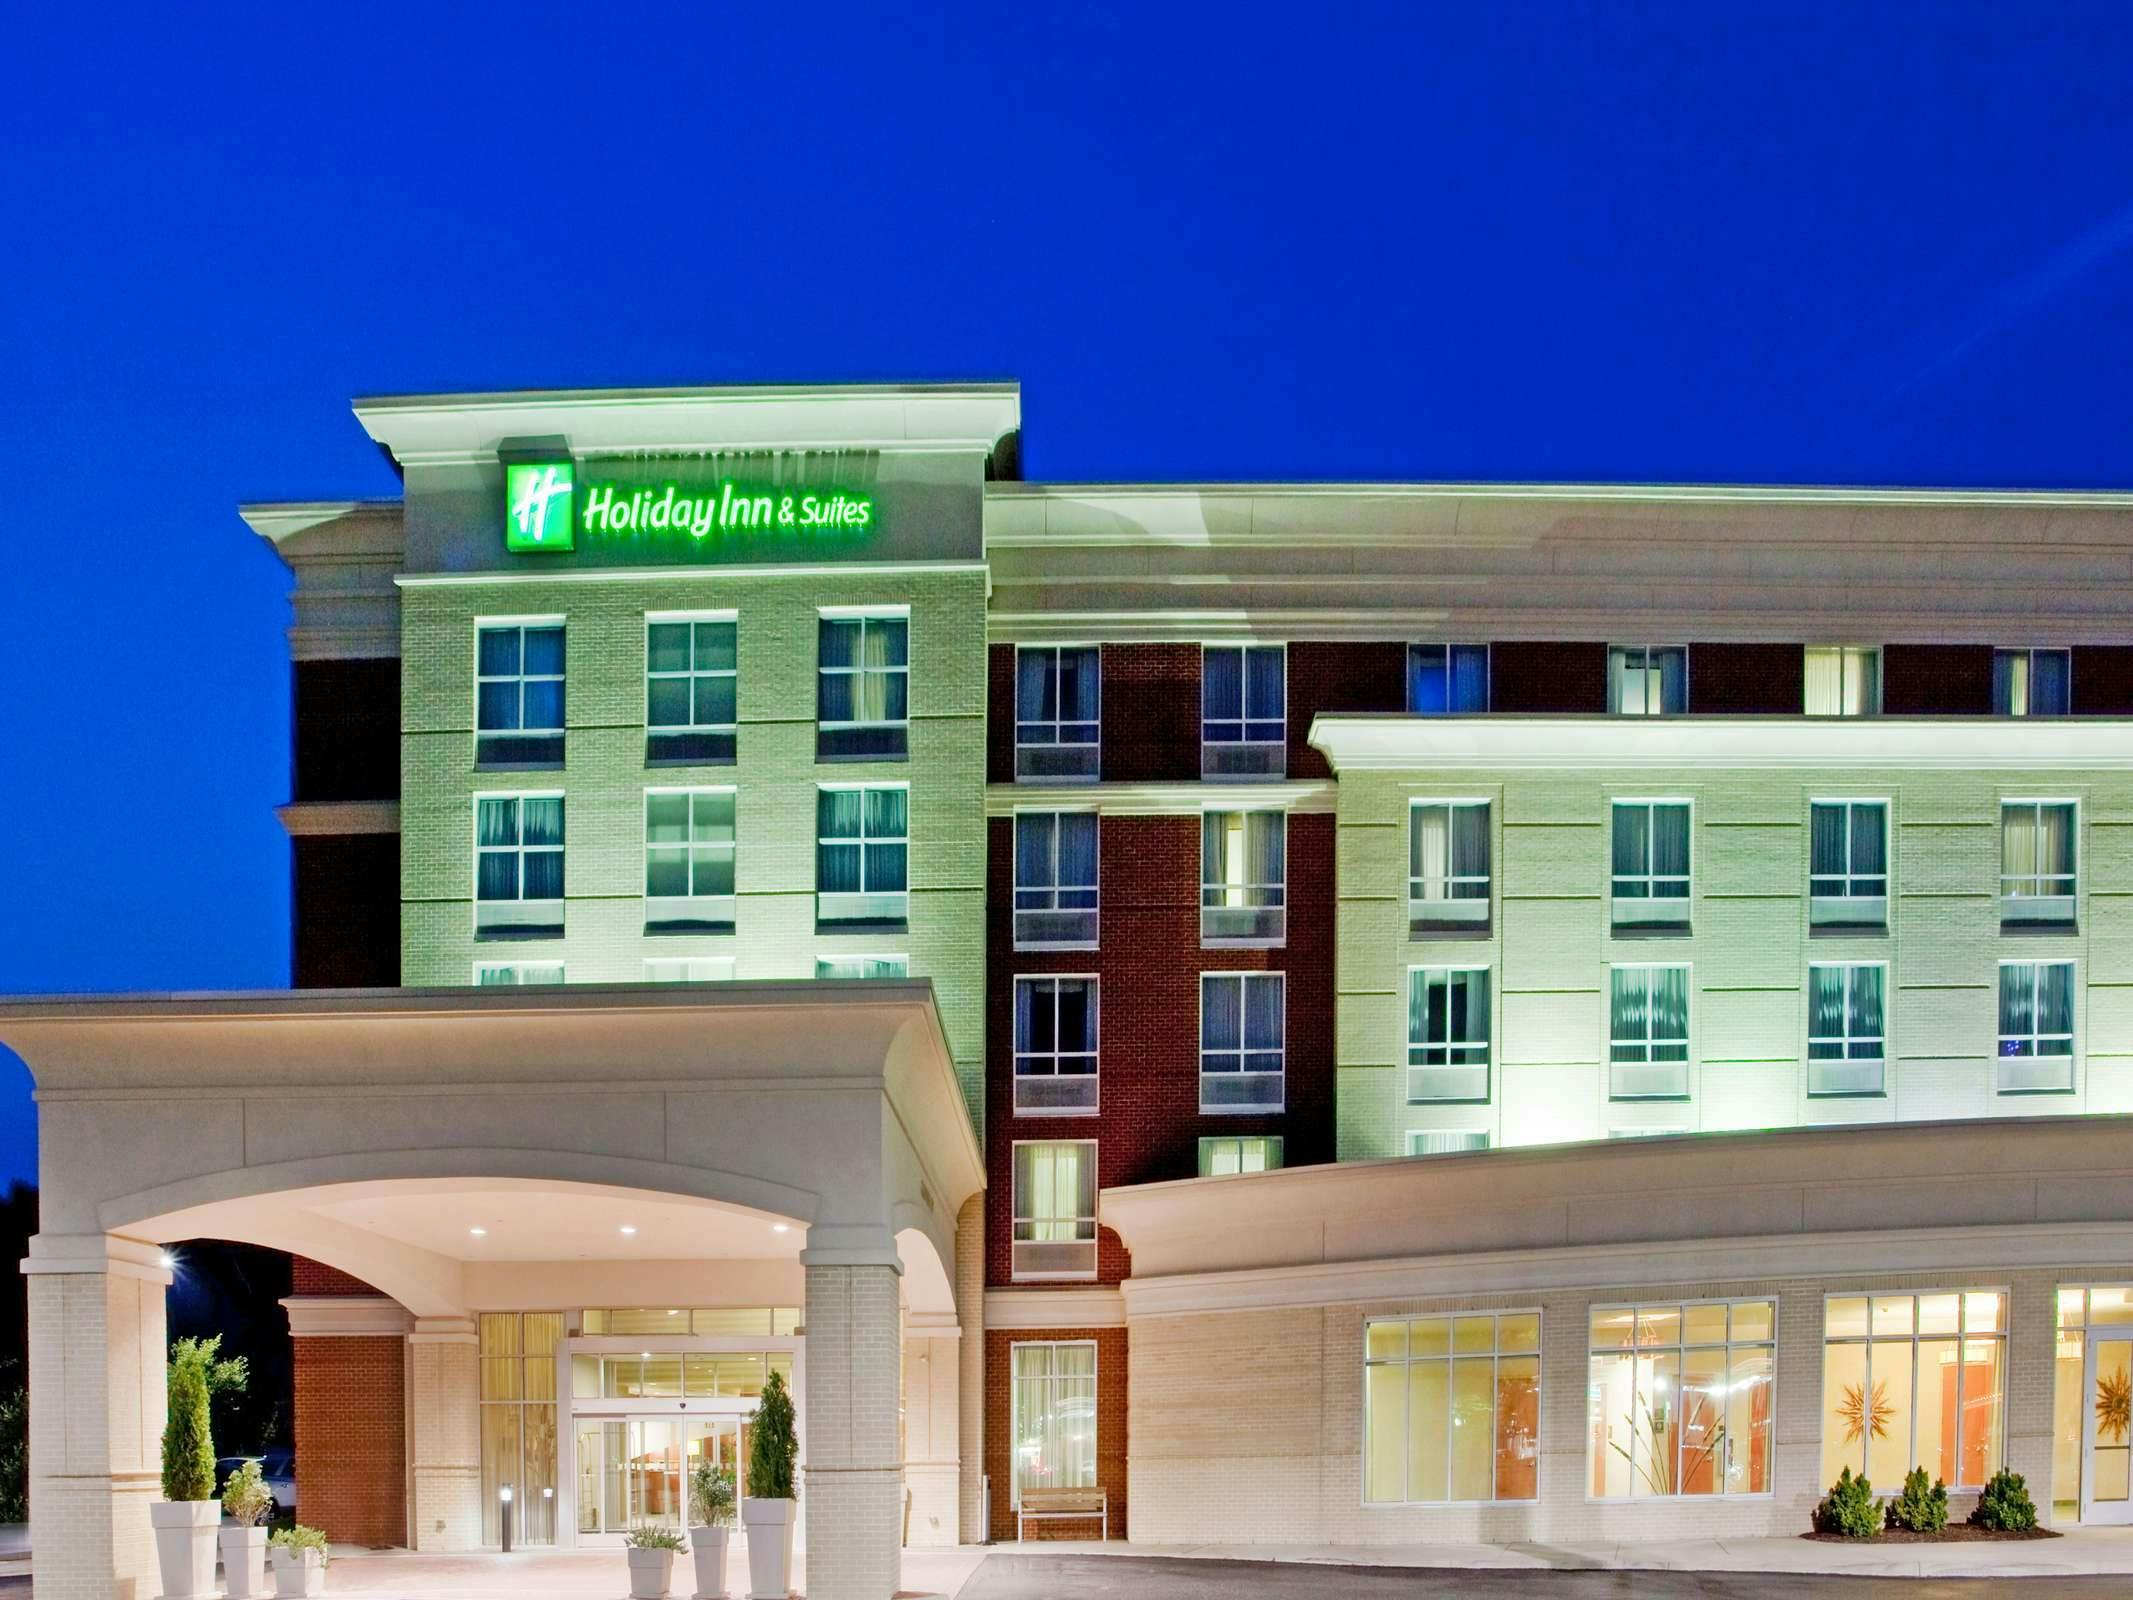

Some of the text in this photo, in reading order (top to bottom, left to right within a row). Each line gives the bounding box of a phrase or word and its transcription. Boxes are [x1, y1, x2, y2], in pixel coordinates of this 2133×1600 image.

[583, 484, 870, 537] Holiday Inn & Suites
